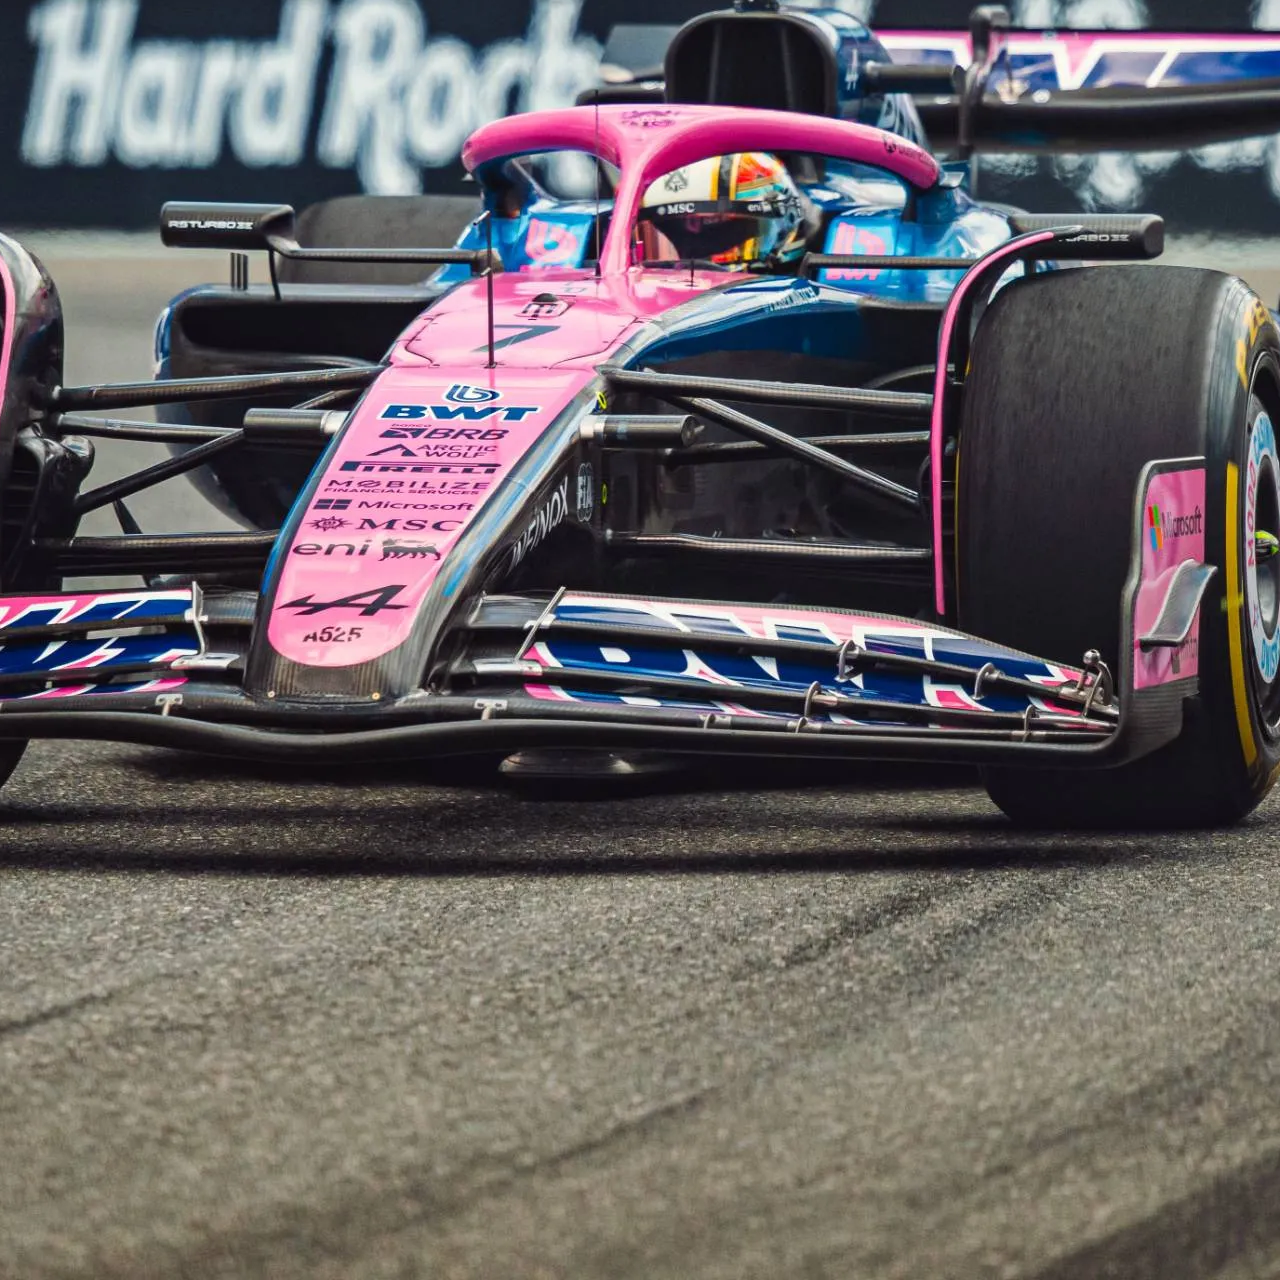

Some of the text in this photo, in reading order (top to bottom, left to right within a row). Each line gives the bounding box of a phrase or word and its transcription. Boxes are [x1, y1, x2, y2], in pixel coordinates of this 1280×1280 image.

[667, 202, 696, 215] MSC
[474, 324, 559, 354] 7
[379, 404, 541, 421] BWT
[423, 427, 510, 441] BRB
[416, 443, 498, 452] ARCTIC
[423, 451, 489, 459] WOLF
[338, 460, 503, 475] PIRELLI
[407, 488, 481, 496] SERVICES
[357, 500, 476, 512] Microsoft
[354, 518, 464, 532] MSC
[1161, 505, 1203, 539] Microsoft
[291, 539, 373, 557] eni
